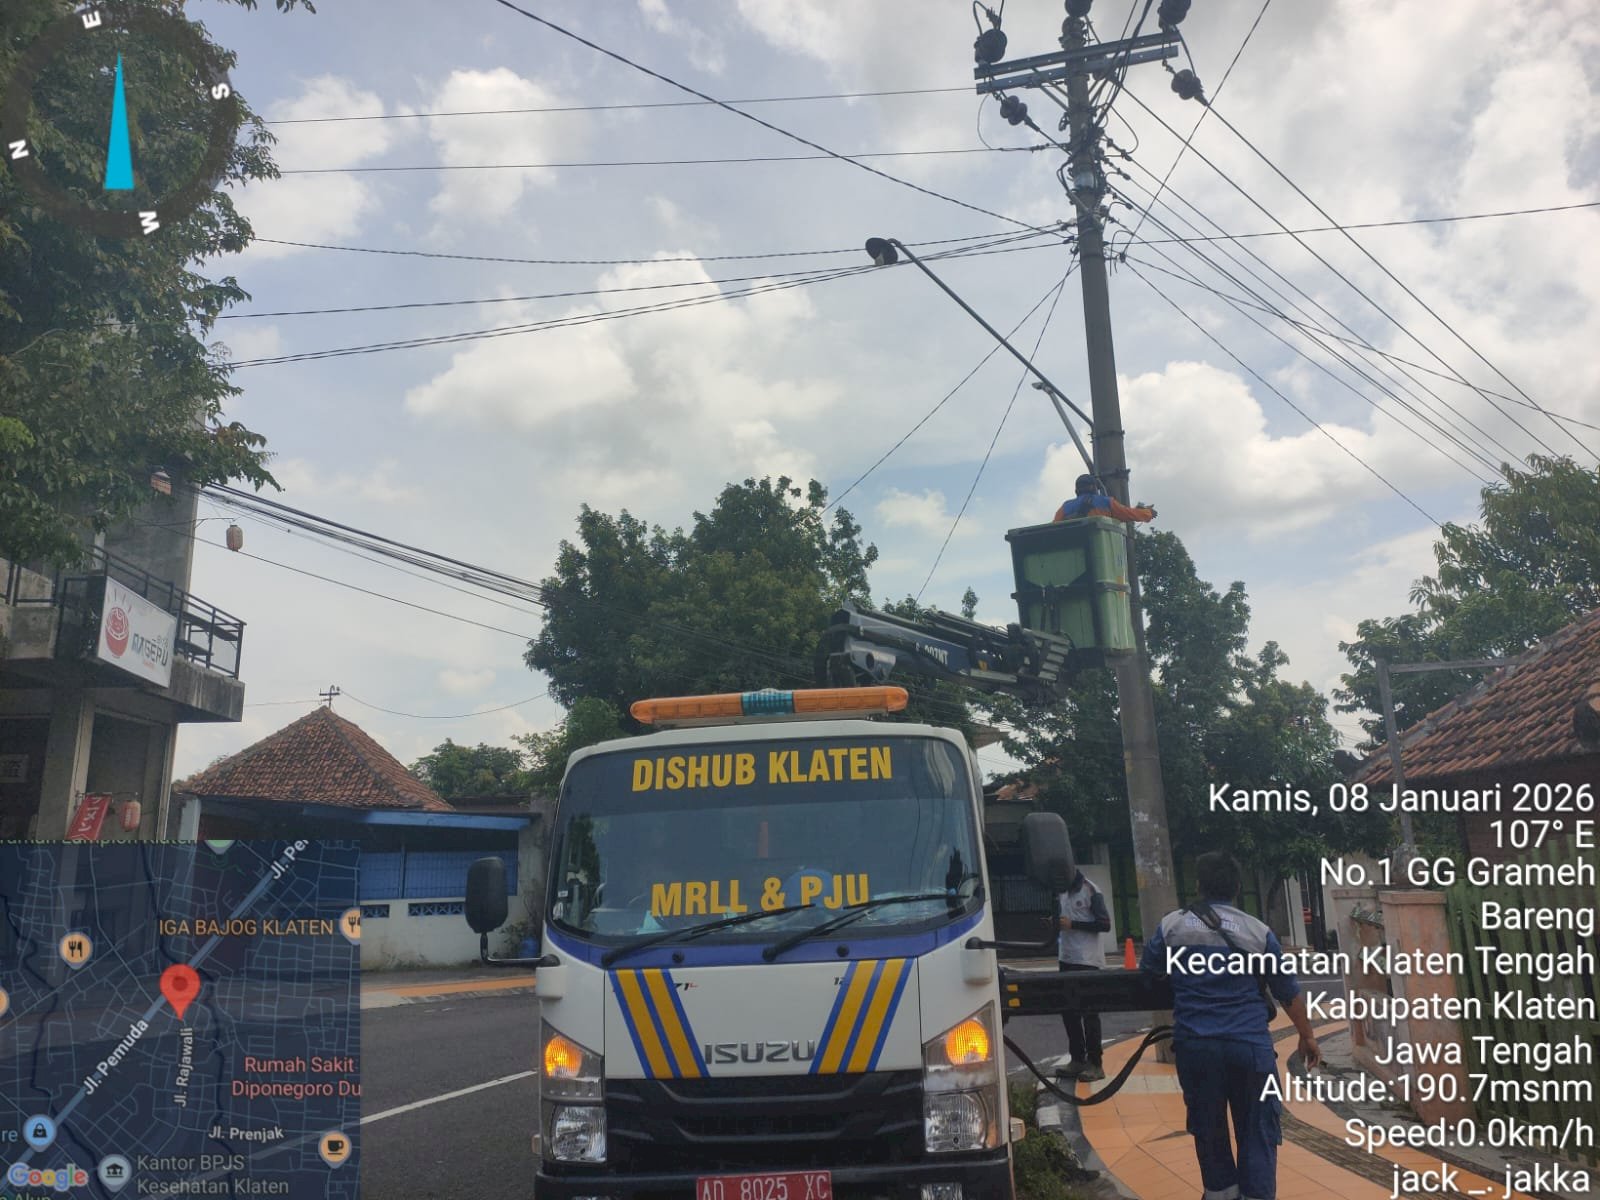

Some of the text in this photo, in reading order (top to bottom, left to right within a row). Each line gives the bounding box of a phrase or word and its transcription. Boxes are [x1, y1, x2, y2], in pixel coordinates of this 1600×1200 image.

[632, 746, 892, 791] DISHUB KLATEN
[651, 874, 869, 917] MRLL & PJU
[704, 1039, 815, 1065] ISUZU
[740, 1176, 788, 1200] 8025
[804, 1174, 828, 1200] XC
